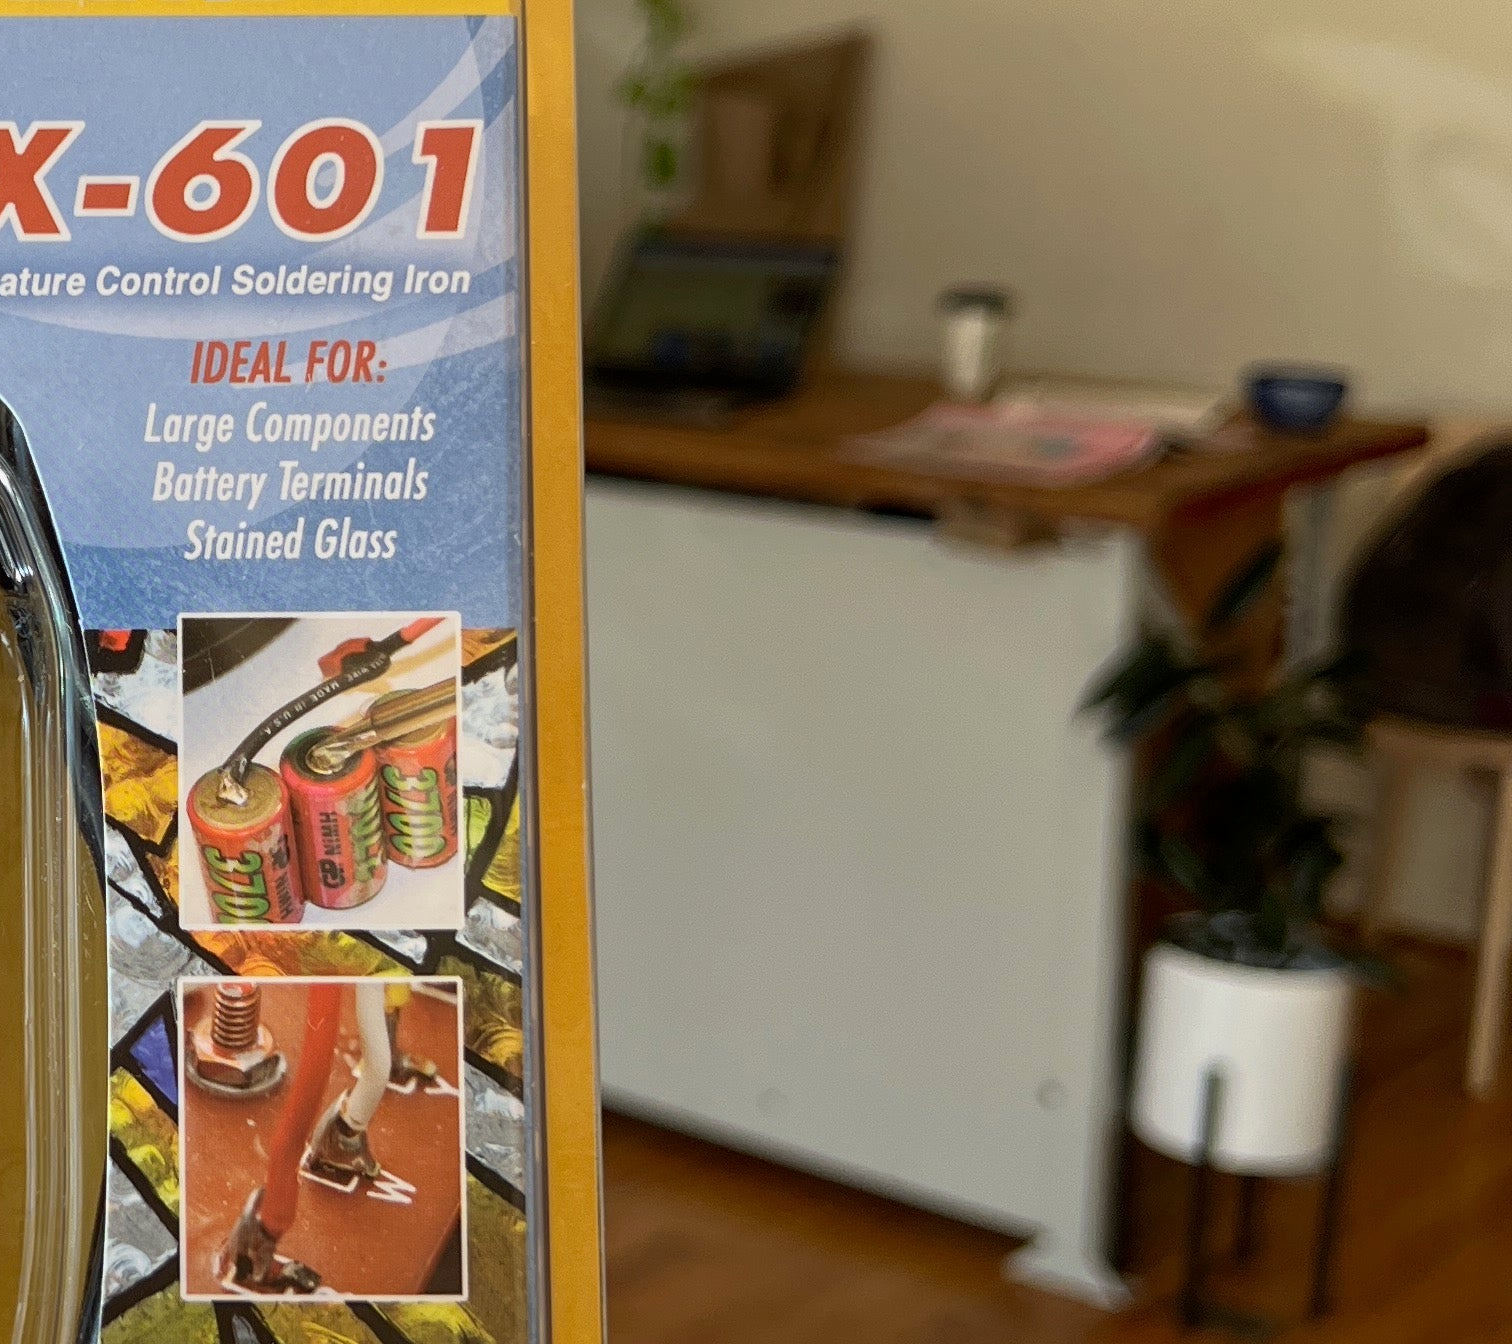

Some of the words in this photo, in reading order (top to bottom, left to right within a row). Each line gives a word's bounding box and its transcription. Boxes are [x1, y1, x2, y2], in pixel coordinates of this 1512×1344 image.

[94, 265, 221, 297] Control
[231, 264, 394, 301] Soldering
[403, 264, 471, 295] Iron
[189, 340, 291, 384] IDEAL
[304, 340, 388, 385] FOR:
[144, 403, 235, 449] Large
[245, 401, 436, 447] Components
[152, 461, 269, 510] Battery
[279, 459, 429, 502] Terminals
[184, 518, 305, 561] Stained
[314, 517, 397, 559] Glass
